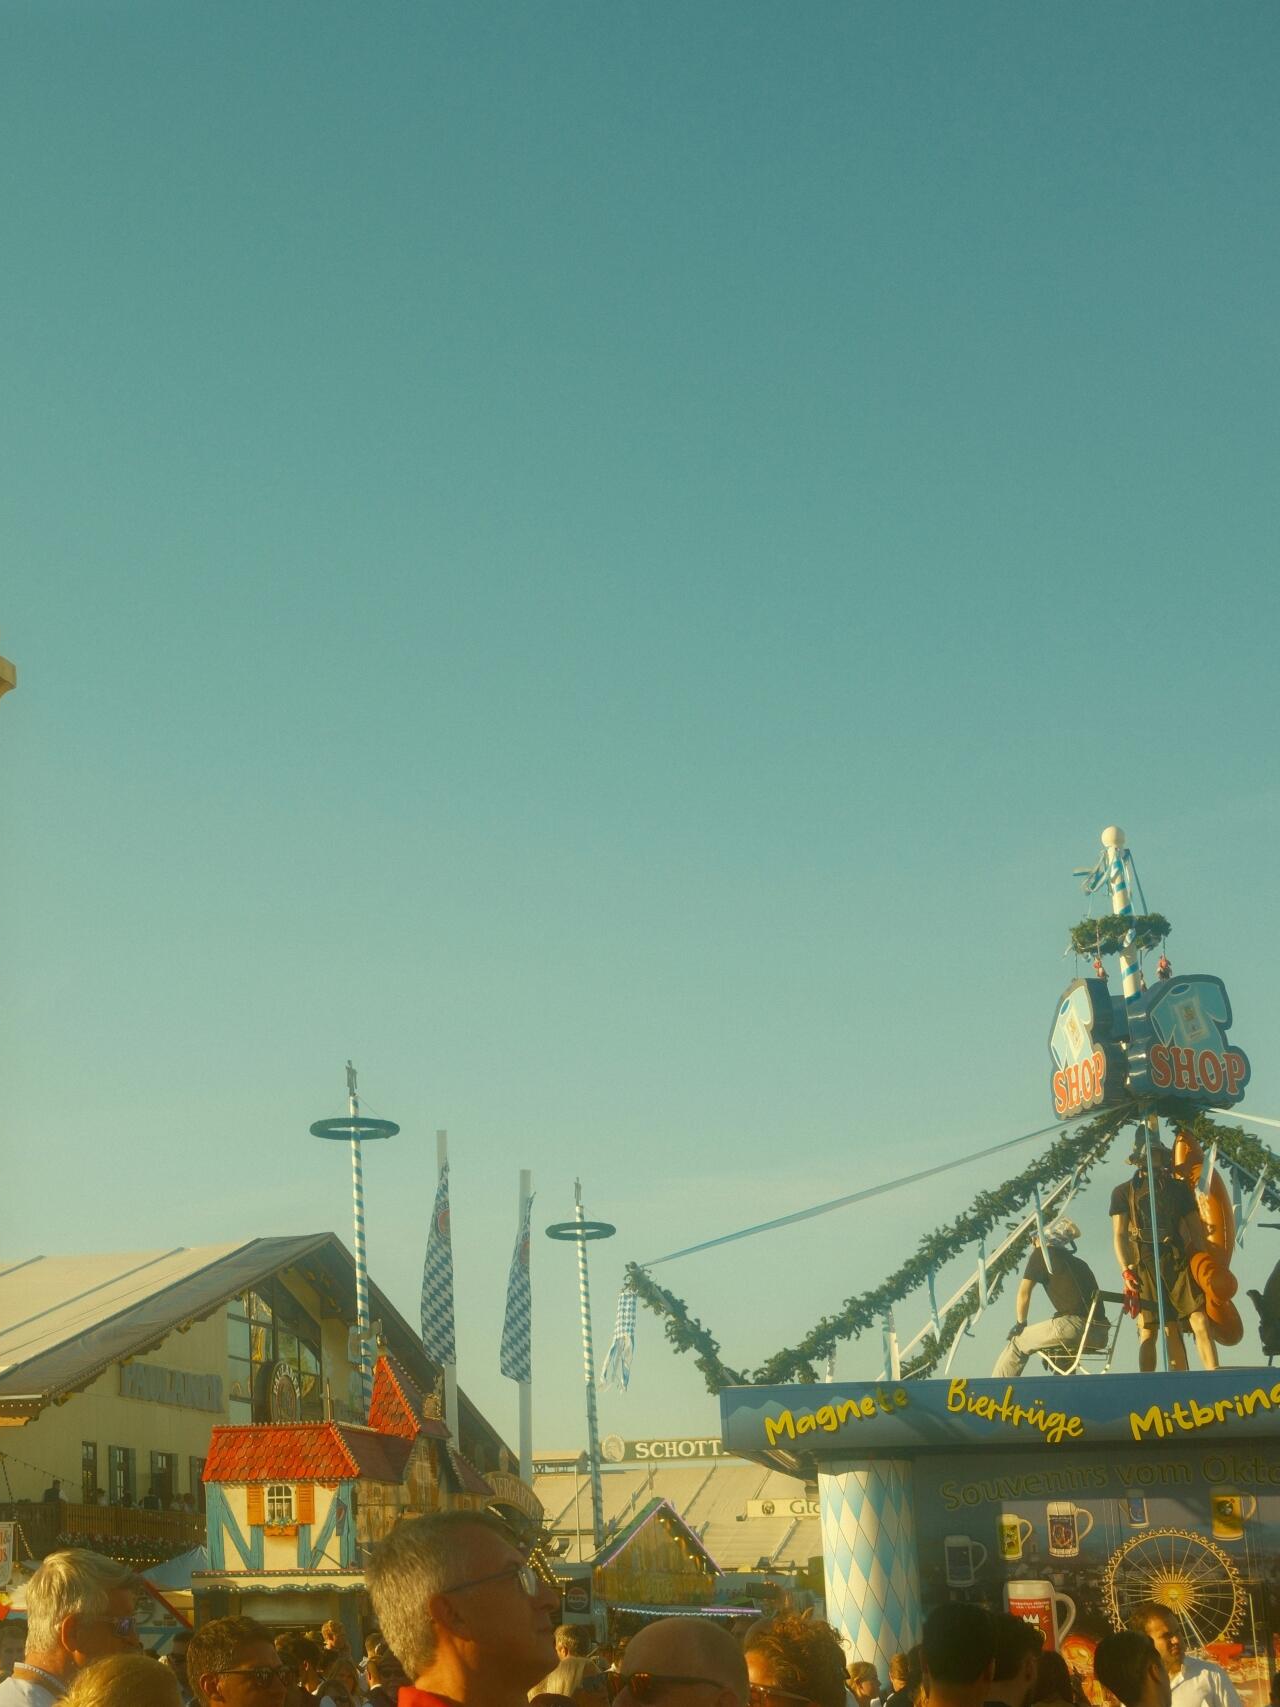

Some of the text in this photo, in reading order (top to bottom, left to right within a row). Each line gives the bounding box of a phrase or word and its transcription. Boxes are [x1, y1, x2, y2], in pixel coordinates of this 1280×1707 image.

[1053, 1051, 1104, 1113] SHOP
[1150, 1044, 1246, 1095] SHOP
[763, 1386, 909, 1446] Magnete
[946, 1376, 1084, 1443] Bierkrüge
[635, 1440, 730, 1459] SCHOTT
[938, 1463, 1108, 1511] Souvenirs
[1114, 1460, 1193, 1487] vom
